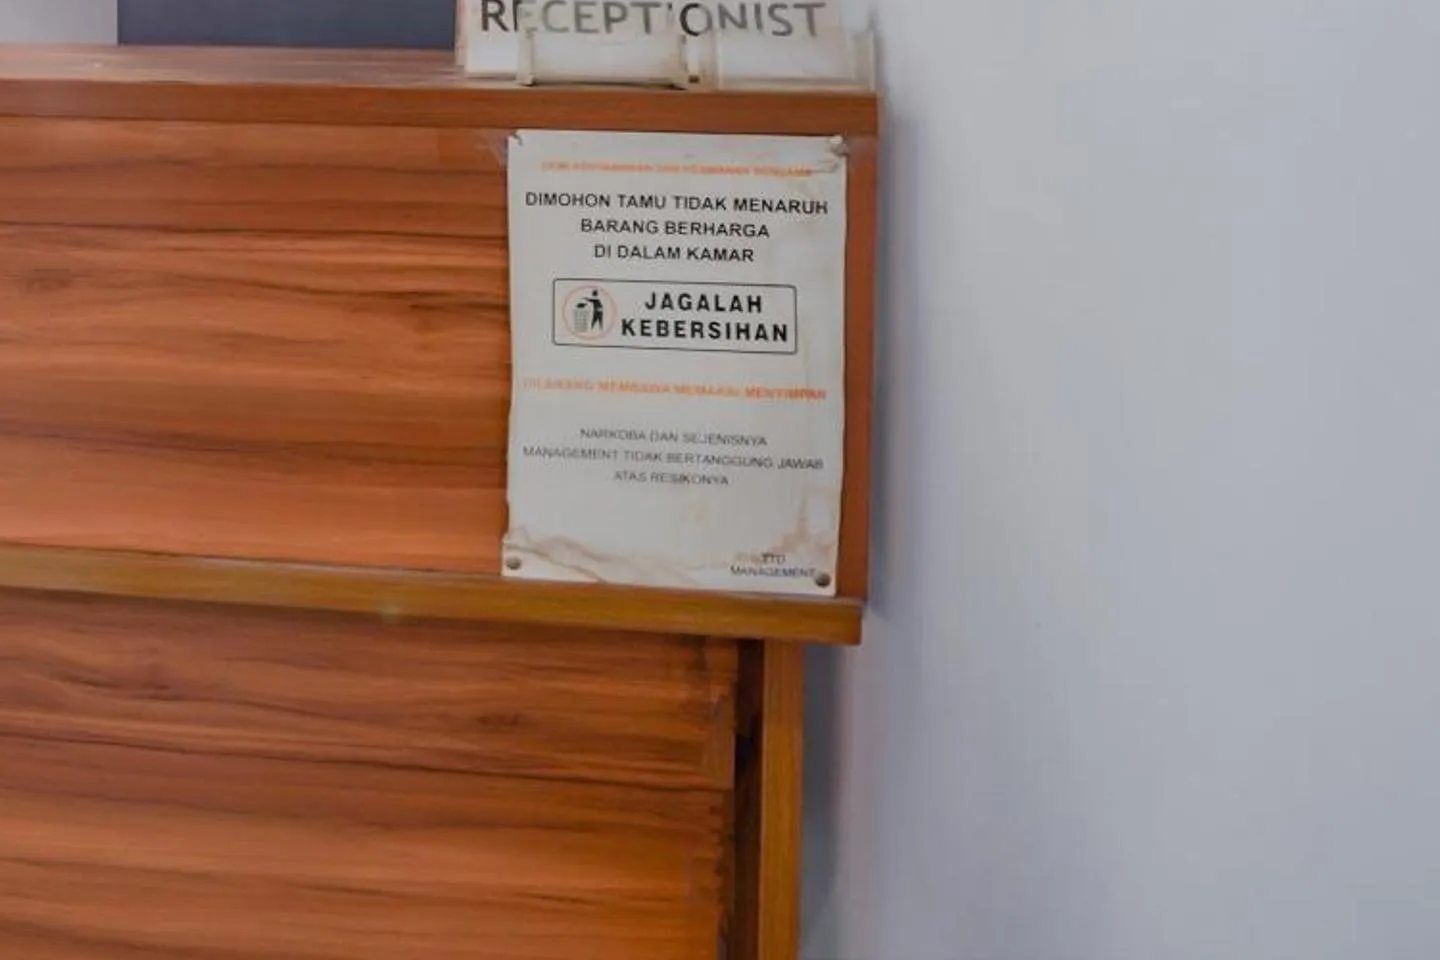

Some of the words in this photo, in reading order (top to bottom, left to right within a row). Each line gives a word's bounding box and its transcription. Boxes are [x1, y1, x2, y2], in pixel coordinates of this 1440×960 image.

[525, 191, 611, 209] DIMOHON
[618, 195, 666, 211] TAMU
[673, 196, 727, 212] TIDAK
[733, 197, 829, 215] MENARUH
[580, 218, 659, 235] BARANG
[664, 220, 771, 239] BERHARGA
[594, 244, 612, 260] DI
[617, 245, 681, 261] DALAM
[686, 246, 755, 263] KAMAR
[644, 291, 763, 314] JAGALAH
[620, 318, 789, 343] KEBERSIHAN
[579, 428, 646, 442] NARKOBA
[650, 430, 679, 443] DAN
[682, 431, 768, 446] SEJENISNYA
[522, 446, 618, 461] MANAGEMENT
[624, 449, 663, 462] TIDAK
[666, 452, 774, 469] BERTANGGUNG
[777, 456, 825, 470] JAWAB
[613, 470, 648, 484] ATAS
[650, 472, 729, 486] RESIKONYA
